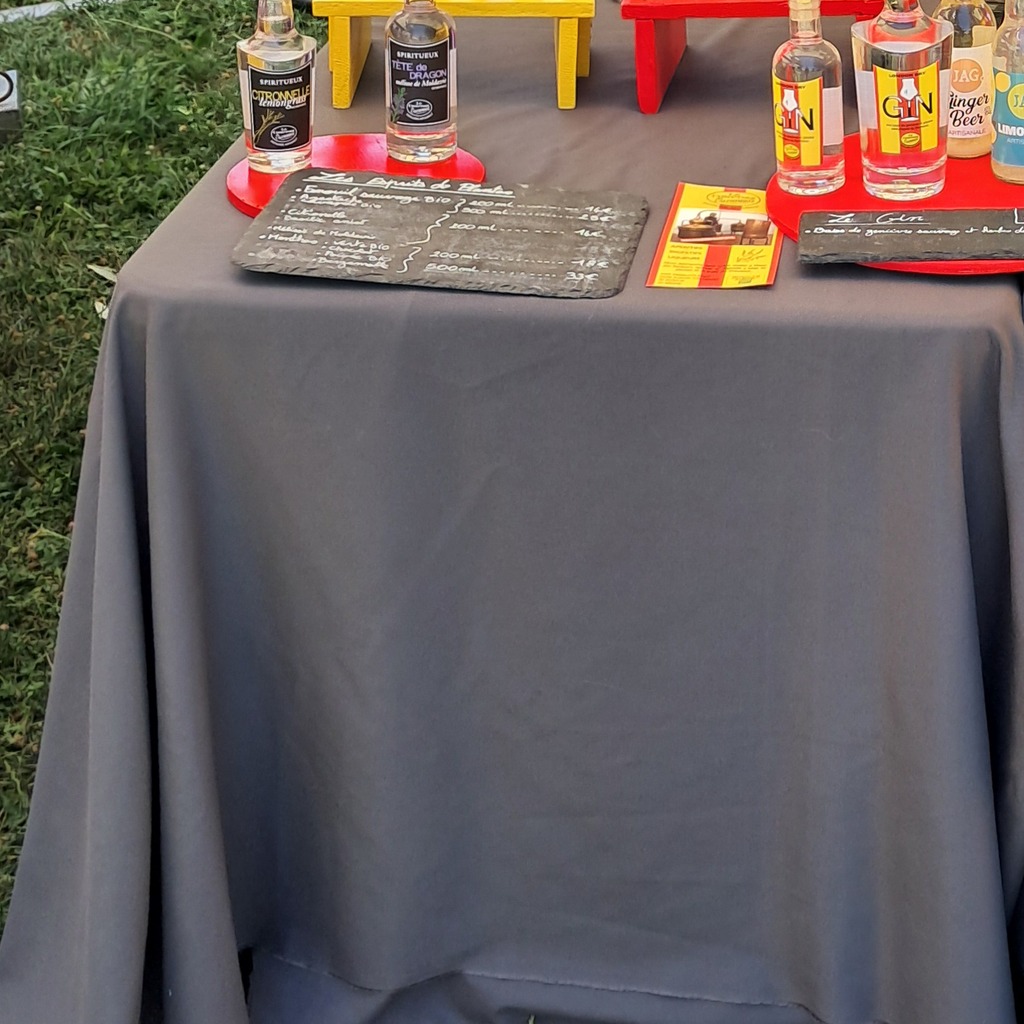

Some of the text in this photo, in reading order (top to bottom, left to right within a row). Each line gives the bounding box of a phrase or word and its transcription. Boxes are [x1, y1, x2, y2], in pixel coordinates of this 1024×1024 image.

[397, 51, 439, 59] SPIRITUEUX
[409, 68, 447, 80] DRAGON
[415, 63, 428, 72] de
[259, 76, 303, 86] SPIRITUEUX
[252, 85, 311, 101] CITRONNELLE
[882, 92, 934, 120] GIN
[774, 102, 815, 132] GIN
[949, 109, 985, 127] Beer
